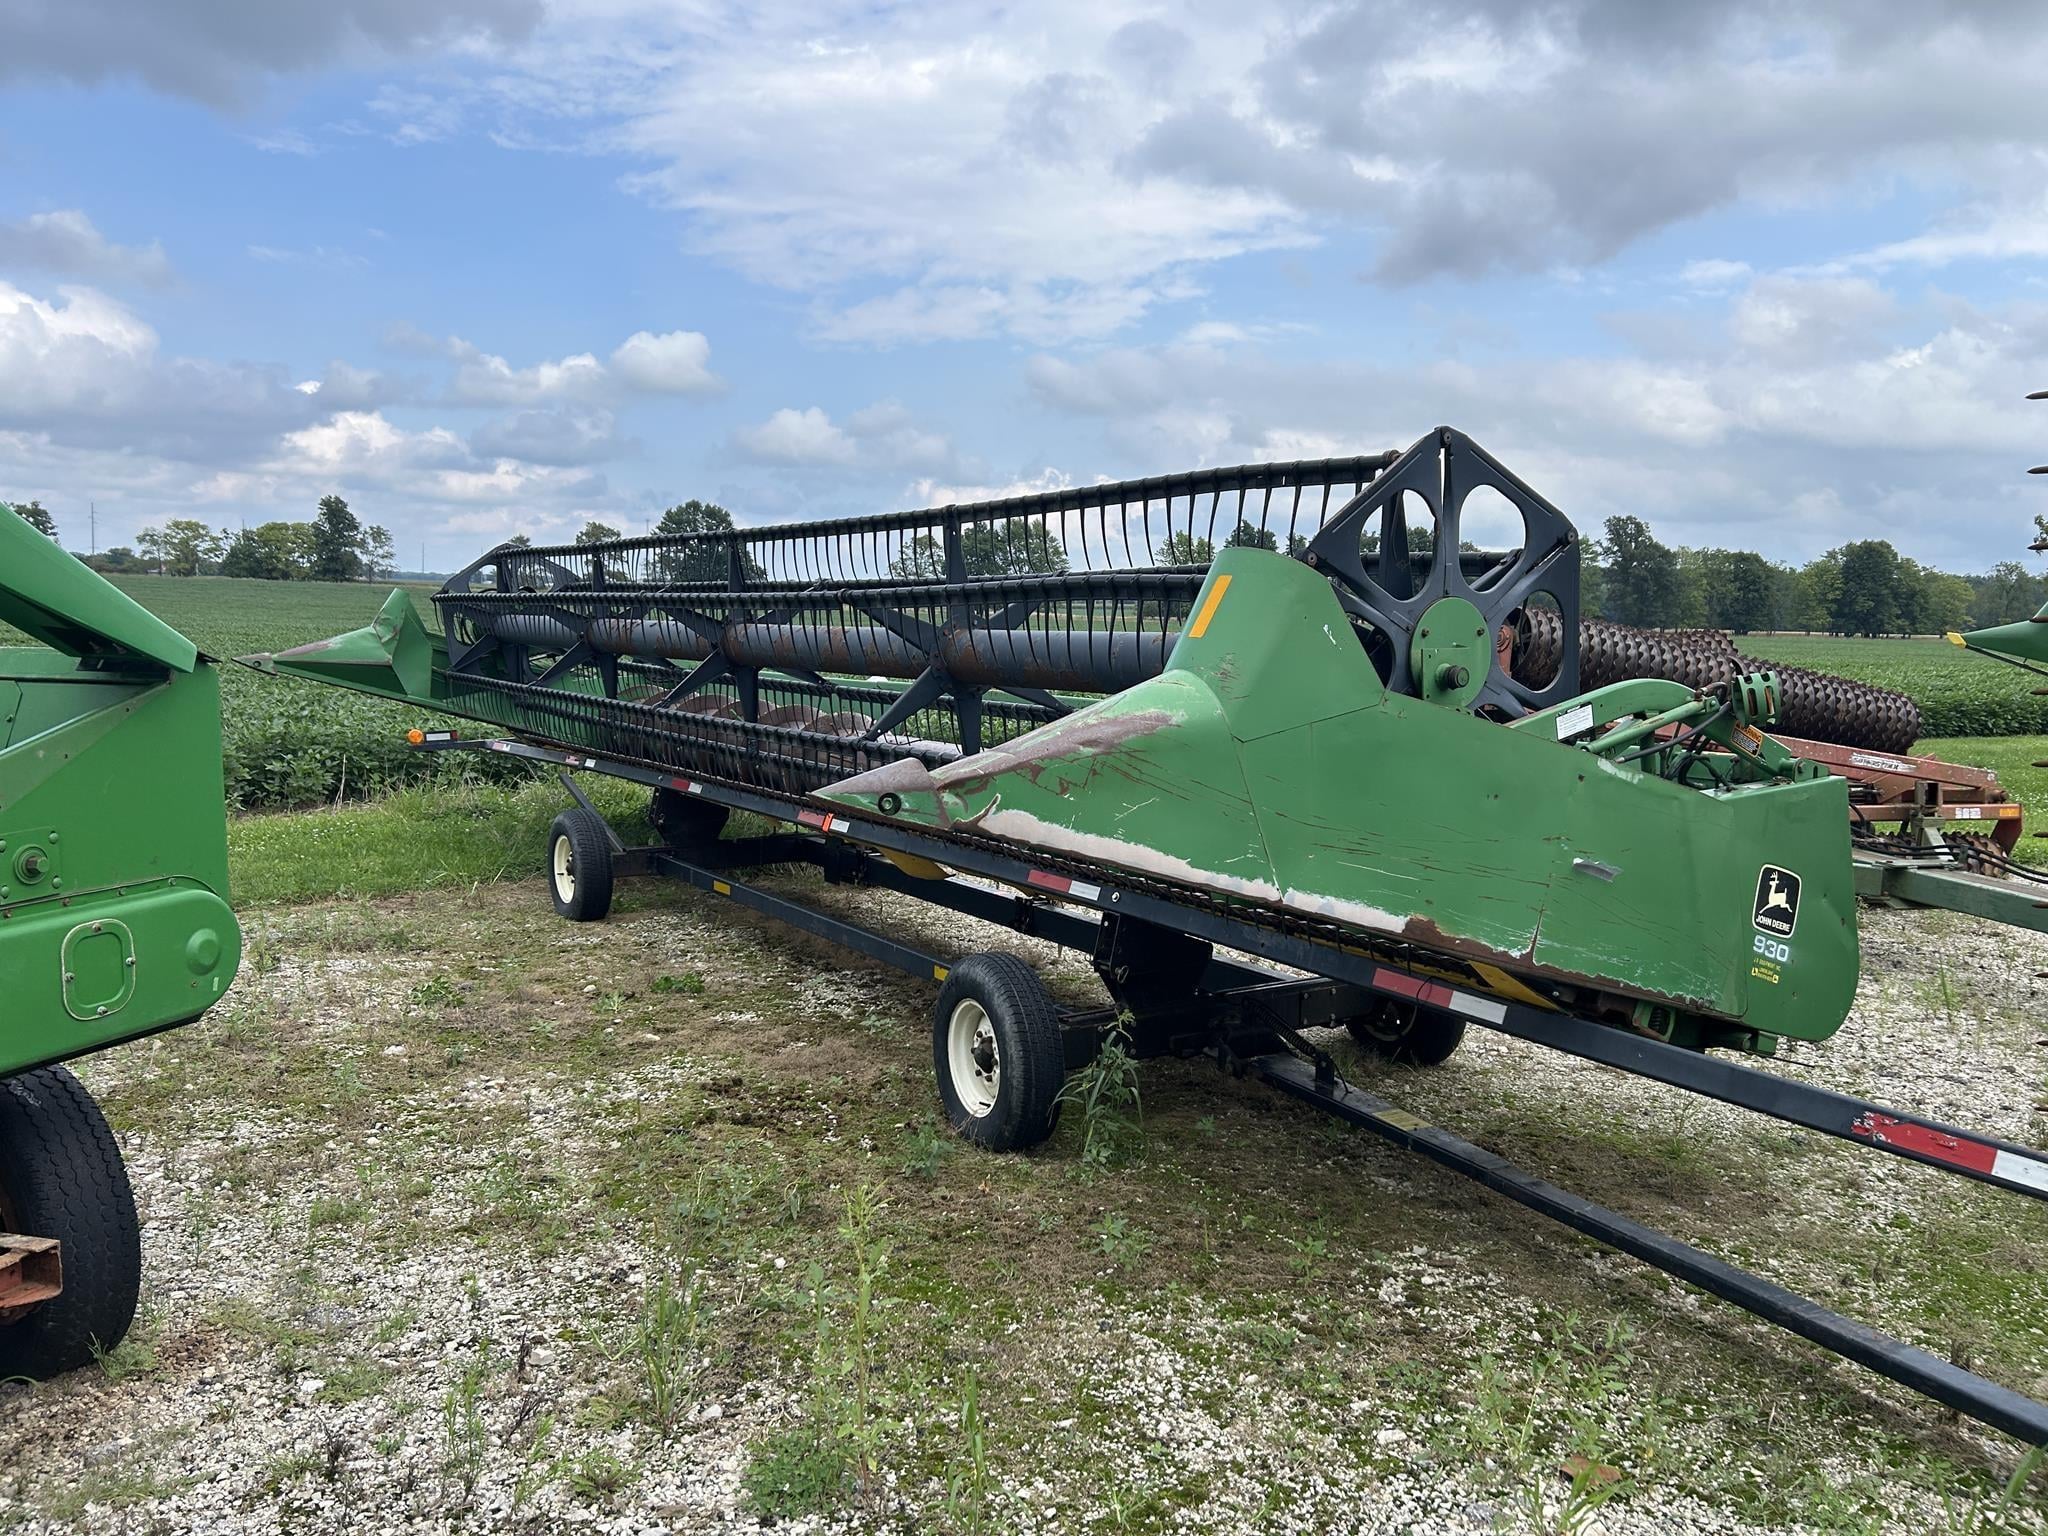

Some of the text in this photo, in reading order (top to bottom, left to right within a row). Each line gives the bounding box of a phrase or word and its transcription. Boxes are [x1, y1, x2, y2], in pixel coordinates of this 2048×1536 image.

[1756, 915, 1791, 932] JOHN DEERE
[1753, 935, 1789, 962] 930
